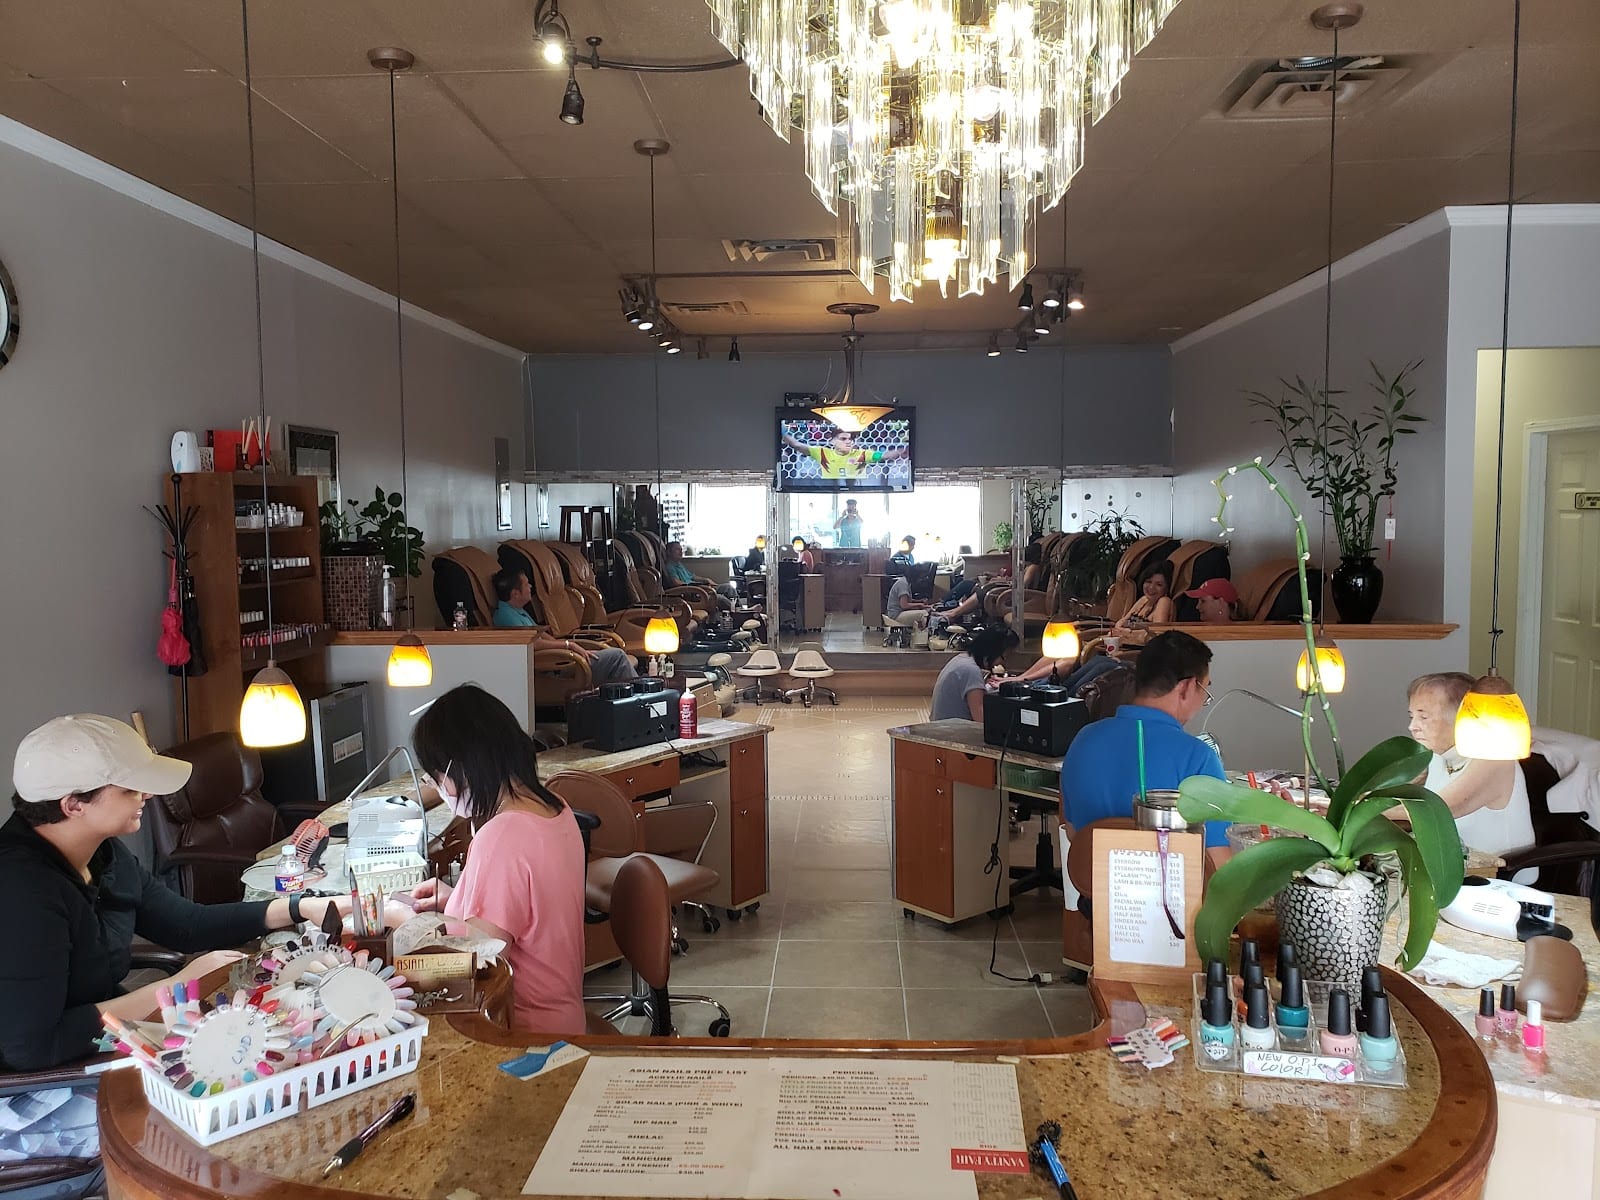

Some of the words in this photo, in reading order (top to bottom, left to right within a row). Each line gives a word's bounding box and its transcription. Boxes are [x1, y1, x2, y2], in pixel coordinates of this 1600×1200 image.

[1258, 1052, 1282, 1062] NEW
[956, 1154, 982, 1166] FAIR
[984, 1154, 1025, 1168] VANITY
